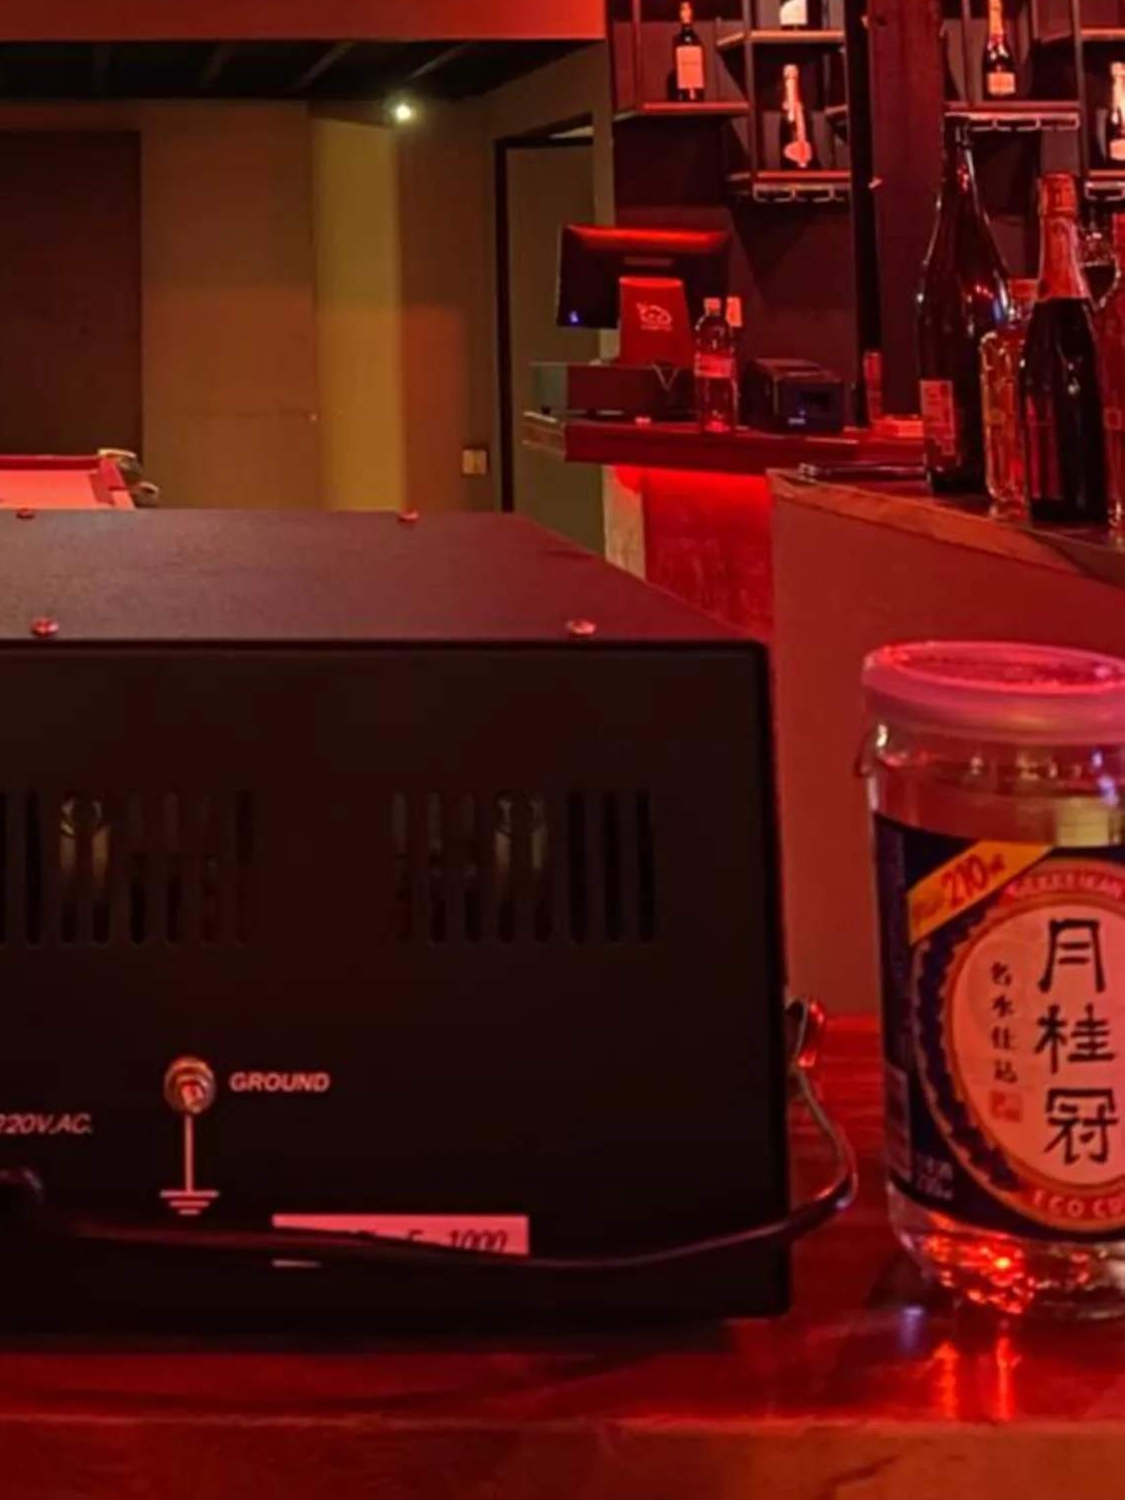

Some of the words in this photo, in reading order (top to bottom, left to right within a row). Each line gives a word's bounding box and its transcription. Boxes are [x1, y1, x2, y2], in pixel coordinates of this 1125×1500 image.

[230, 1072, 330, 1092] GROUND
[1035, 917, 1118, 1164] 月桂冠
